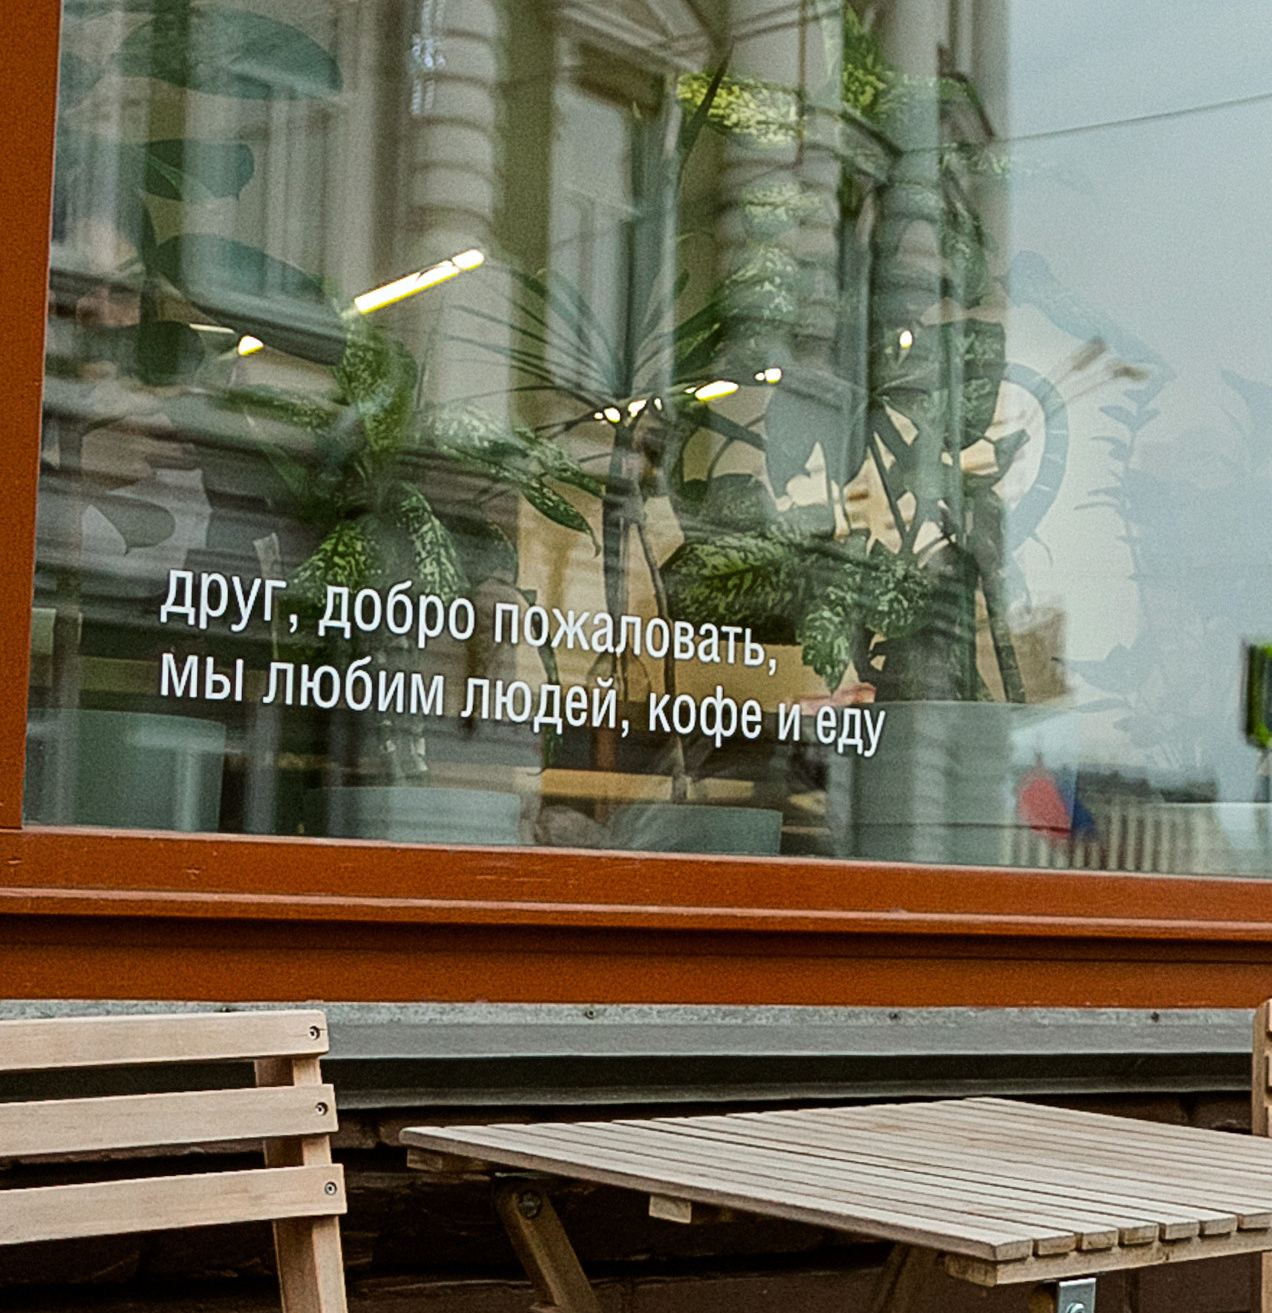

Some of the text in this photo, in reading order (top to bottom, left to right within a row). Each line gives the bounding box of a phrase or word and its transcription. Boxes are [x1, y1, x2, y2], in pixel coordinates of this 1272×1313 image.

[160, 570, 778, 675] друг, добро пожаловать,
[160, 653, 886, 759] мы любим людей, кофе и еду
